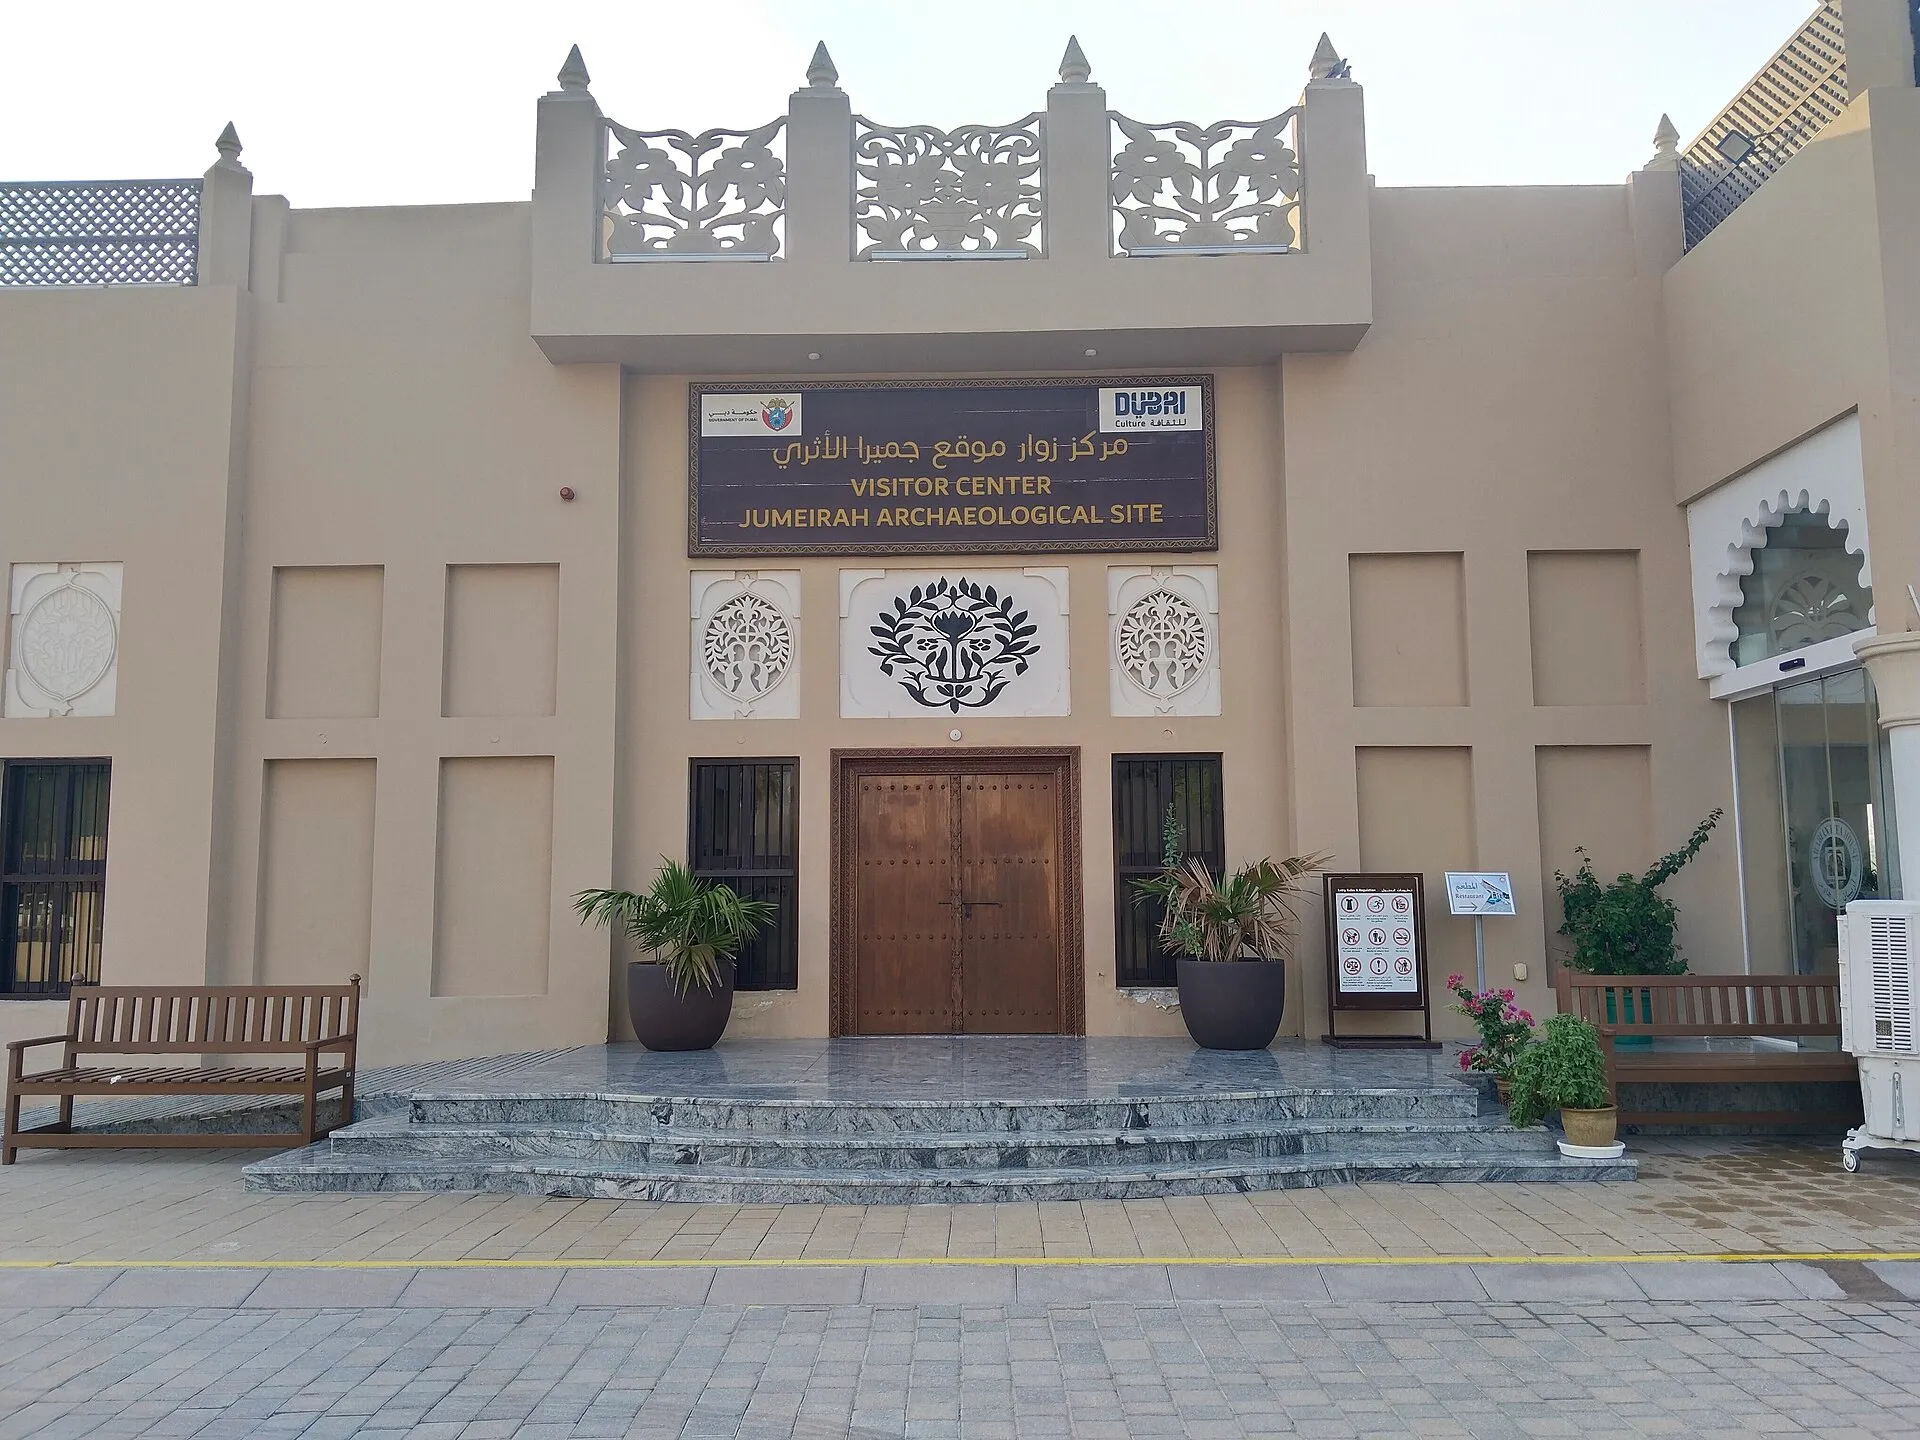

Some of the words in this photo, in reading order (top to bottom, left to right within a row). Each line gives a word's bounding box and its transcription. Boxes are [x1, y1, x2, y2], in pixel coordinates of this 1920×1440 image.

[731, 408, 758, 416] حكومة
[1115, 391, 1186, 416] DUBAI
[1115, 419, 1146, 428] Culture
[1150, 418, 1187, 427] للثقافة
[772, 429, 848, 470] الأثري
[858, 435, 920, 465] جميرا
[931, 434, 1007, 469] موقع
[1017, 433, 1058, 462] زوار
[1068, 430, 1129, 462] مركز
[850, 477, 949, 497] VISITOR
[955, 475, 1052, 496] CENTER
[738, 508, 869, 528] JUMEIRAH
[876, 505, 1103, 527] ARCHAEOLOGICAL
[1110, 503, 1164, 523] SITE
[1455, 882, 1478, 892] المطعم
